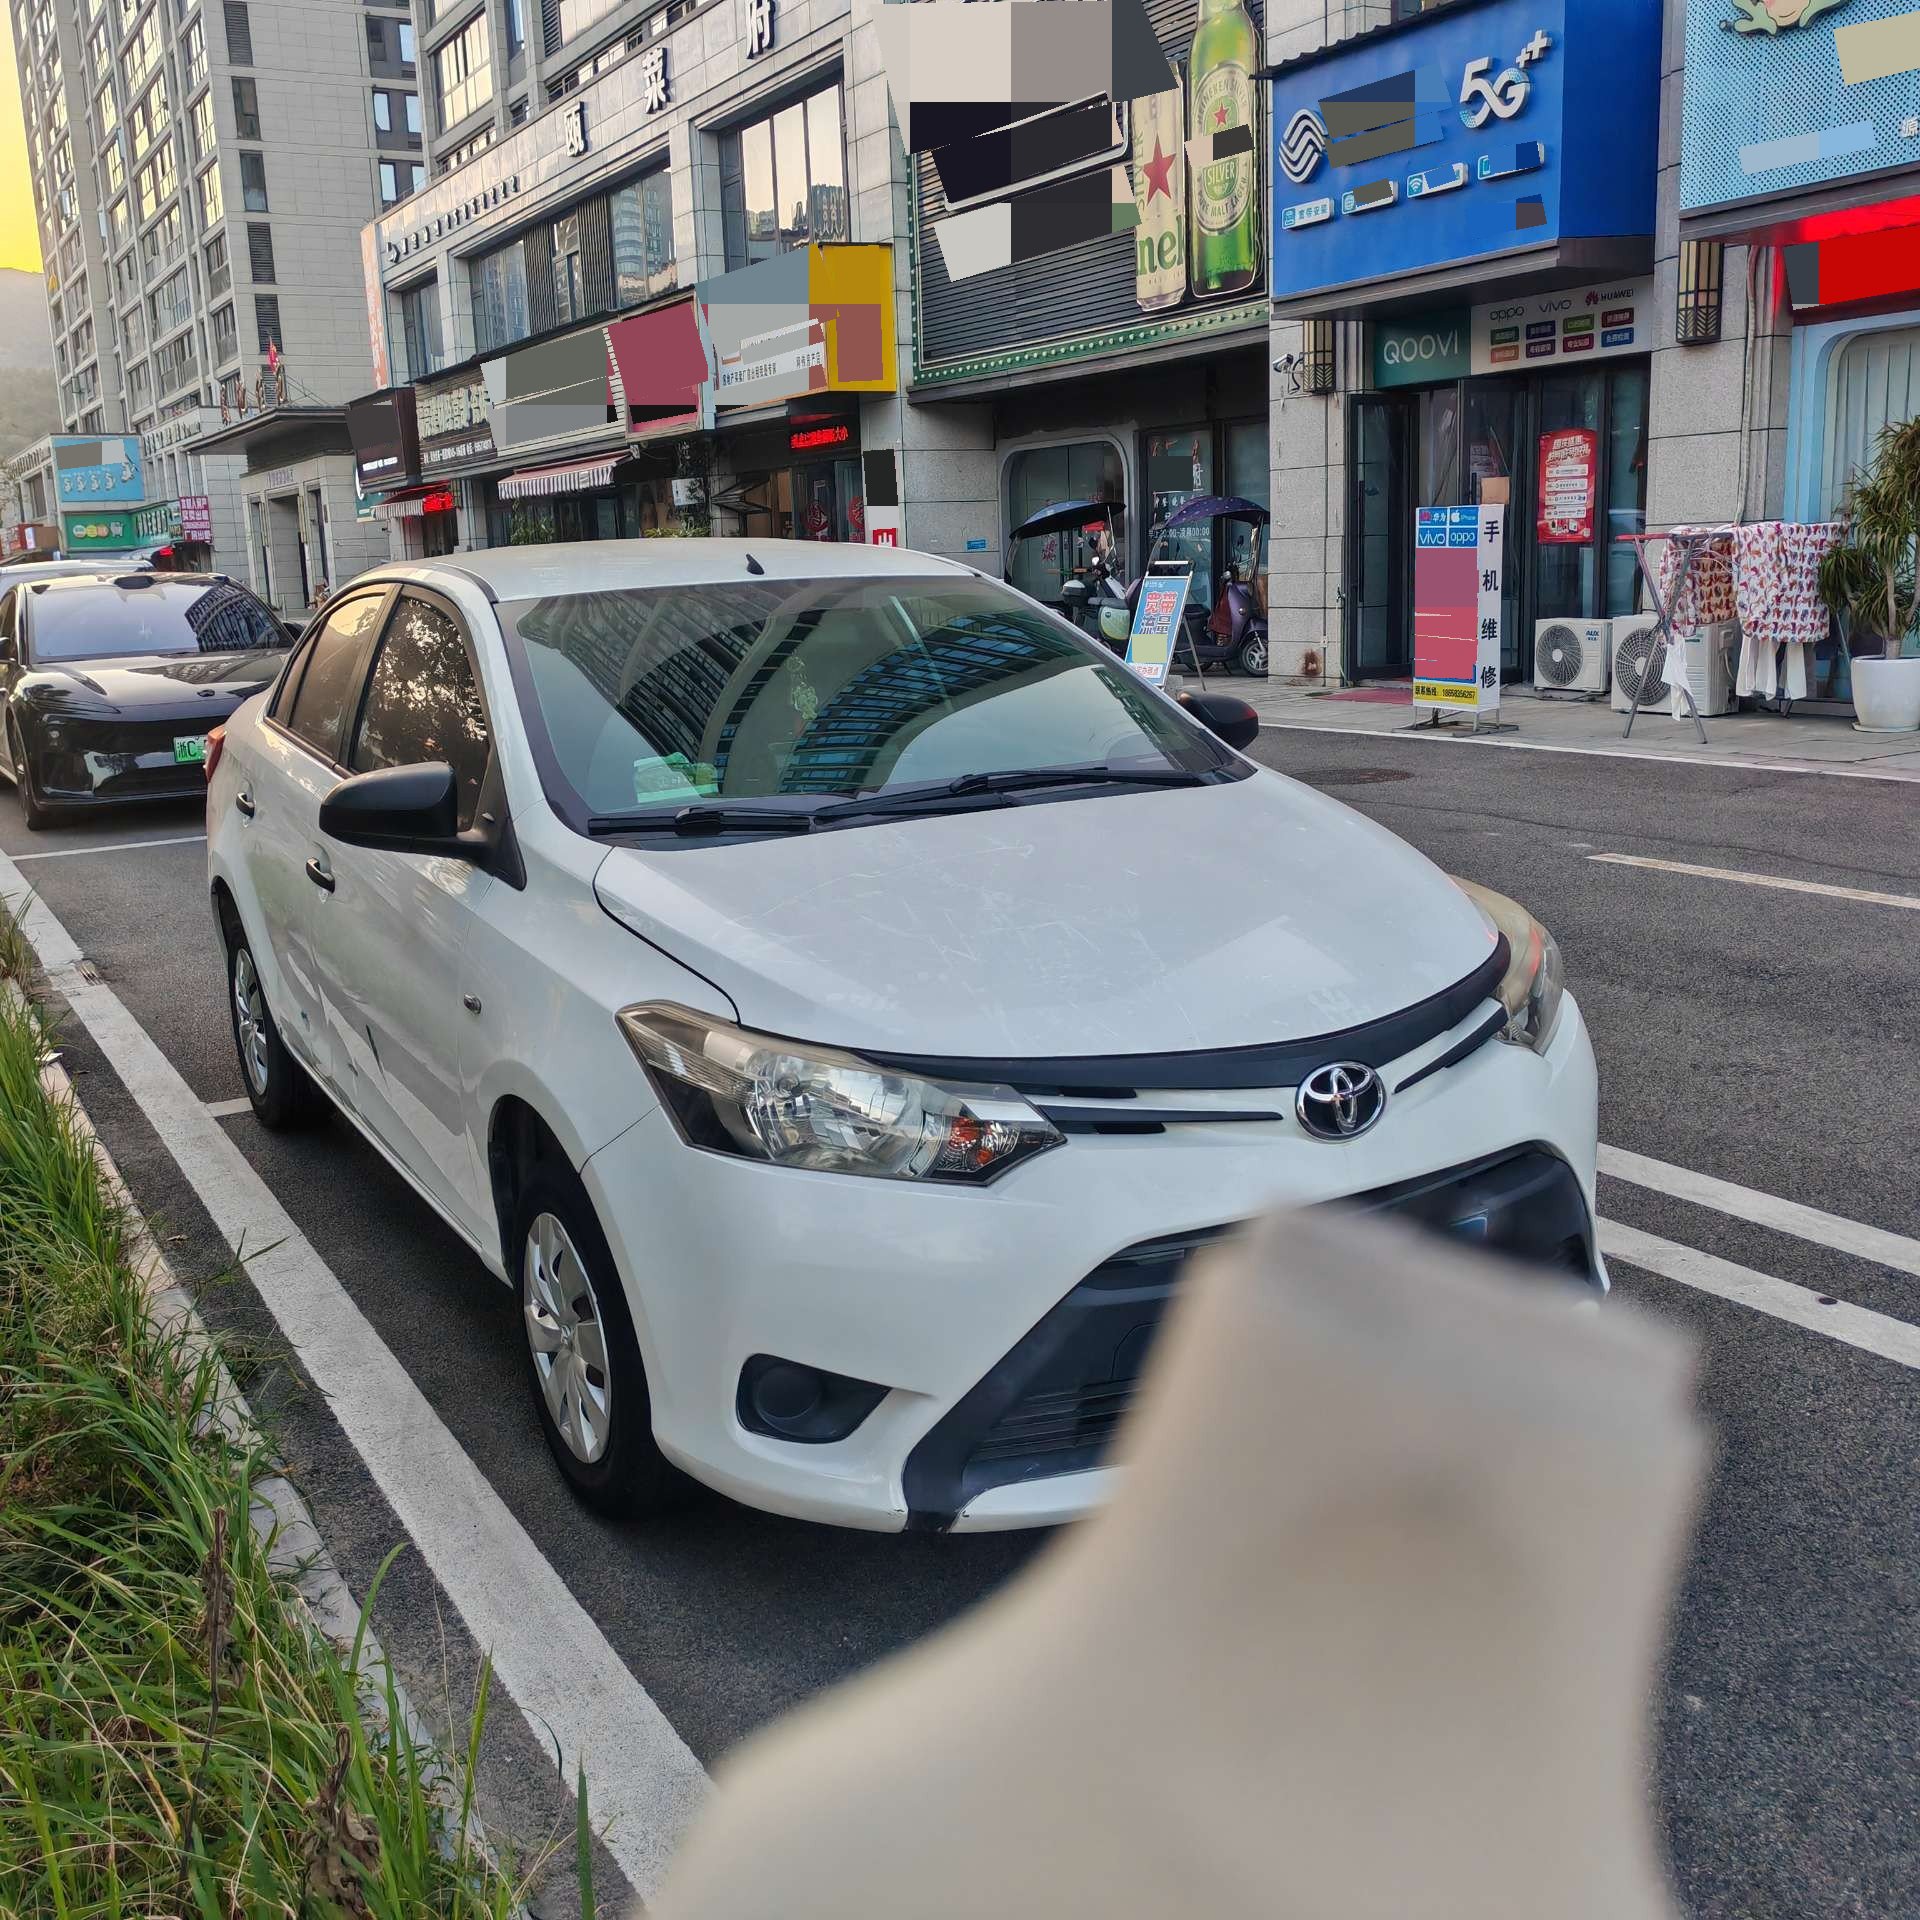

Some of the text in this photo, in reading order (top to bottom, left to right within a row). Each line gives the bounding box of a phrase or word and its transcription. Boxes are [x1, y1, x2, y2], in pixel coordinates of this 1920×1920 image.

[1206, 161, 1236, 186] SILVER
[1601, 288, 1634, 301] HUAWEI
[1489, 305, 1525, 322] oppo
[1383, 329, 1458, 365] QOOVI
[1419, 529, 1446, 545] vivo
[1451, 532, 1476, 545] oppo
[1480, 520, 1500, 689] 手机维修
[1585, 629, 1600, 637] AUX
